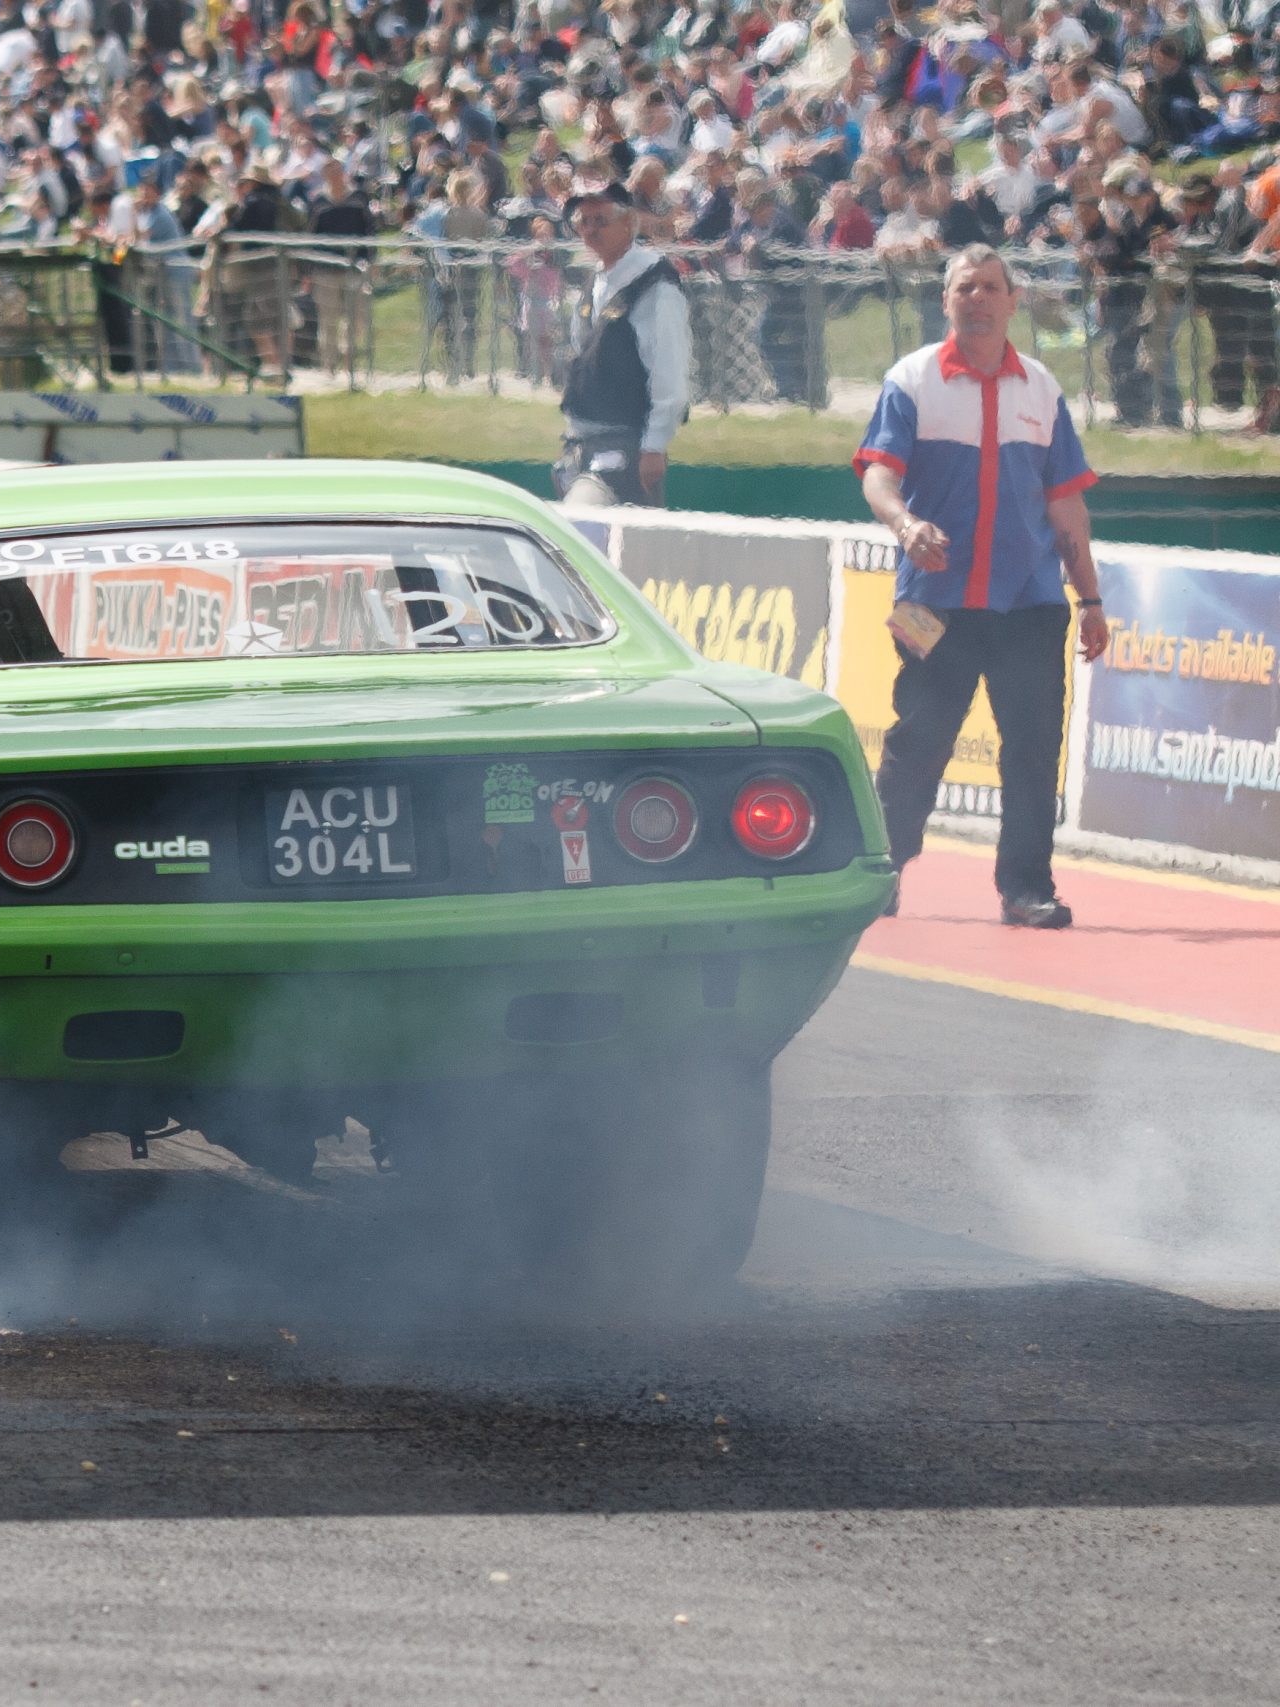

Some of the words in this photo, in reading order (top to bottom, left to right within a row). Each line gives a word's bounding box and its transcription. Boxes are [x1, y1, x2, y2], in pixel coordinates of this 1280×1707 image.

[93, 581, 222, 651] PUKKA-PIES
[1104, 617, 1177, 673] Tickets
[1178, 627, 1276, 685] available
[280, 785, 398, 830] ACU
[583, 780, 615, 803] ON
[114, 835, 210, 859] cuda
[274, 832, 411, 877] 304L
